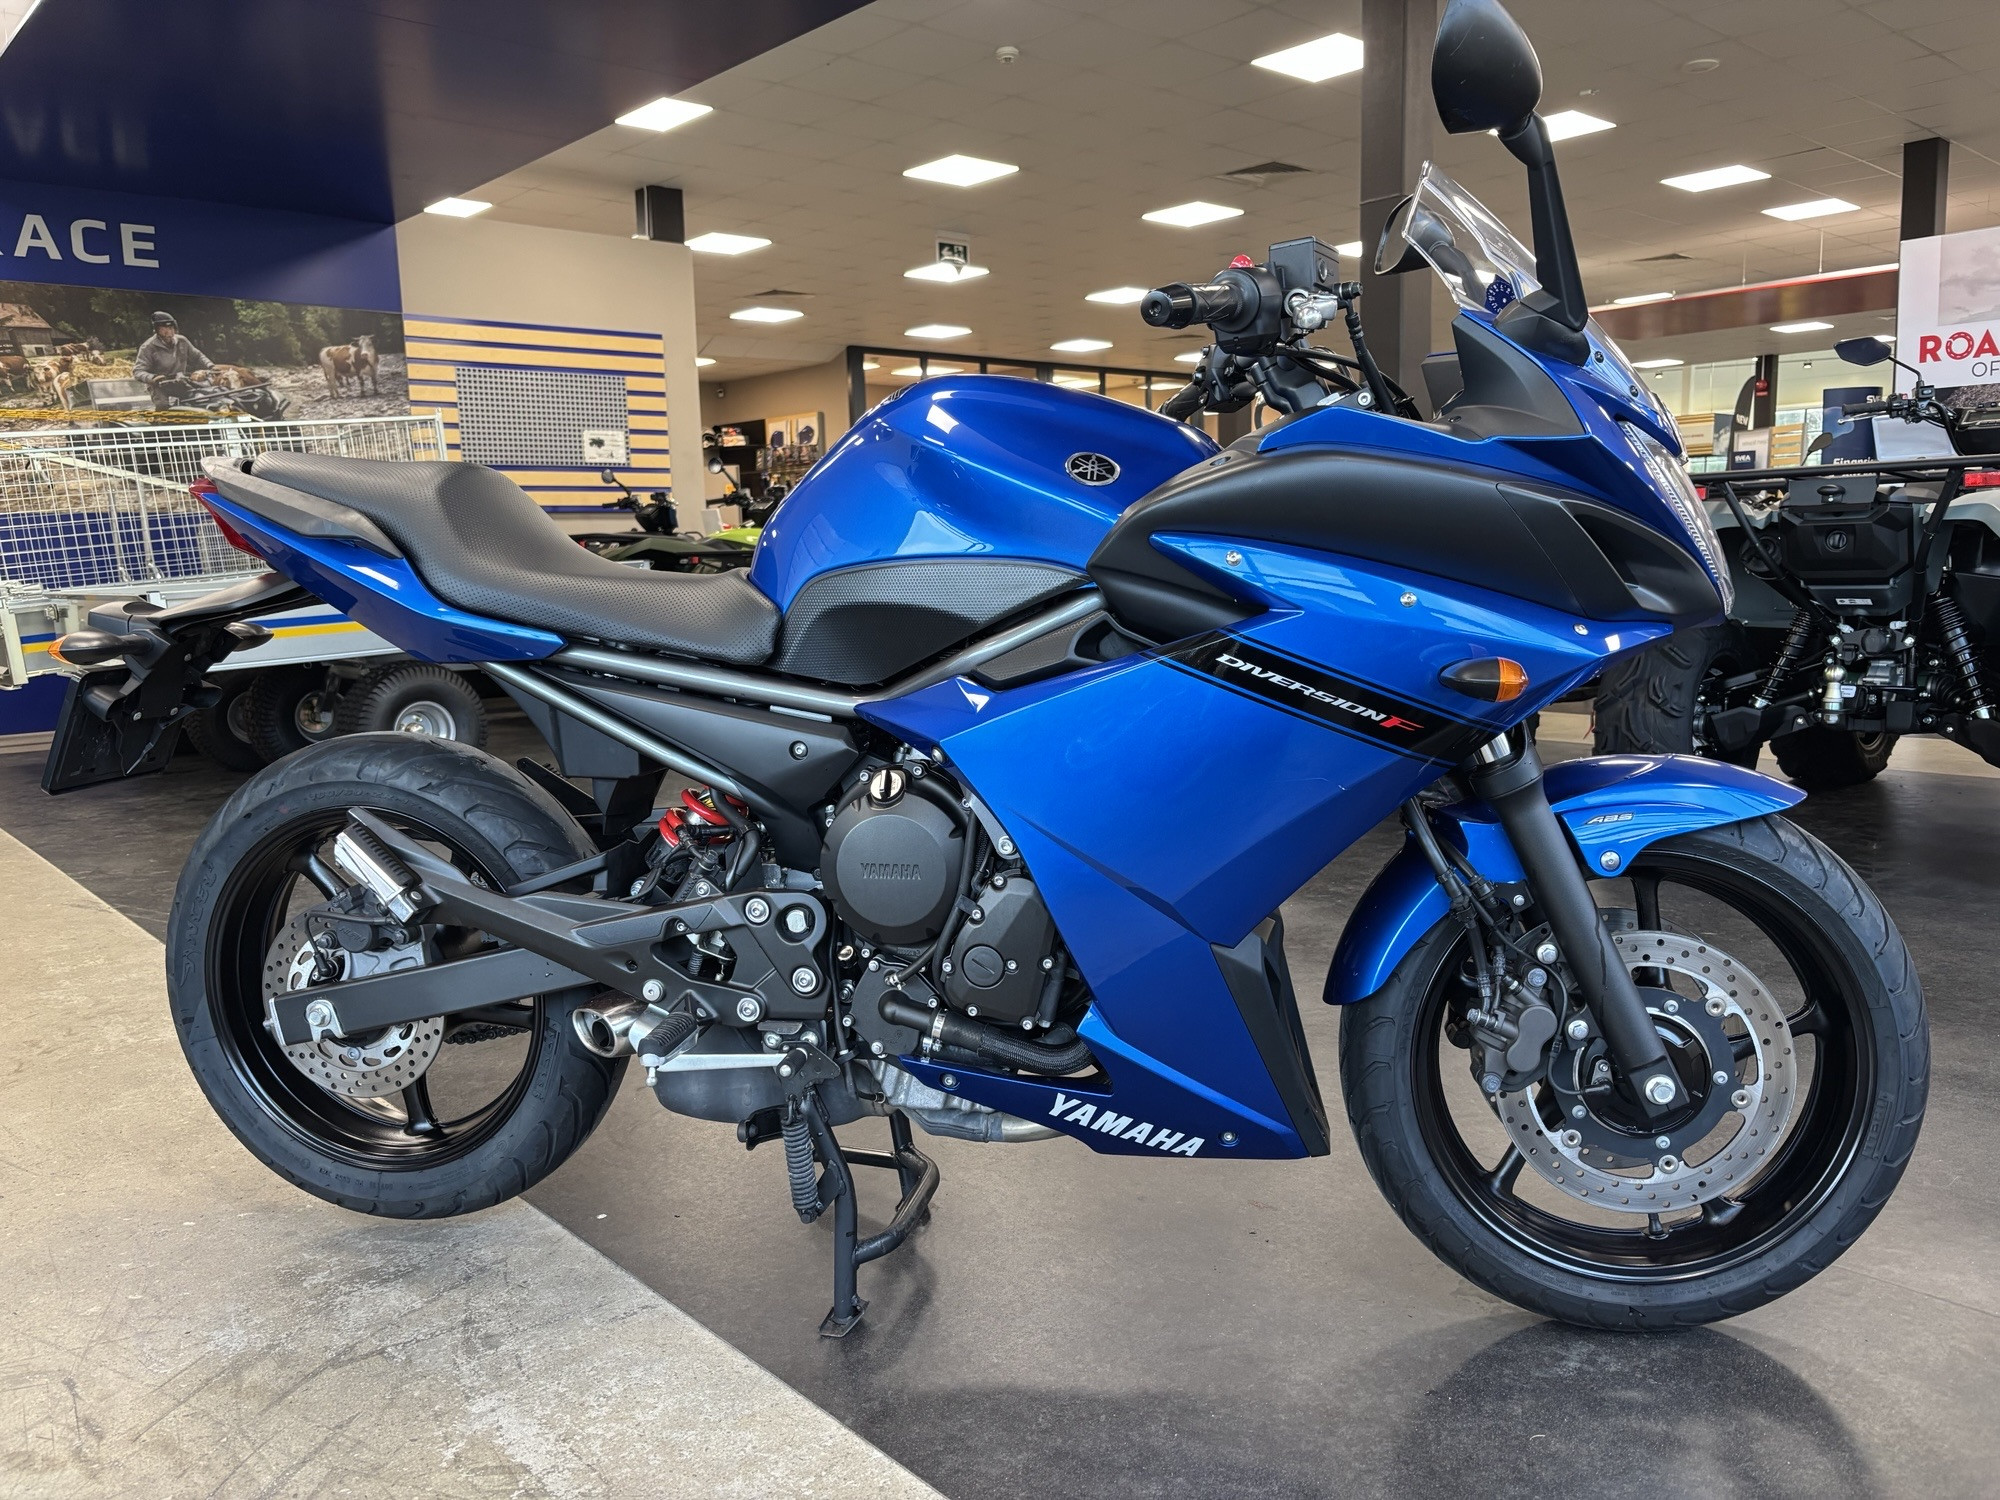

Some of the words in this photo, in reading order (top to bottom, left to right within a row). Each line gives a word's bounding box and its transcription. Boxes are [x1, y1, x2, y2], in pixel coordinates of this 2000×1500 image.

[0, 213, 160, 269] ACE
[1585, 812, 1634, 825] ABS
[860, 863, 922, 881] YAMAHA
[1049, 1092, 1205, 1157] YAMAHA
